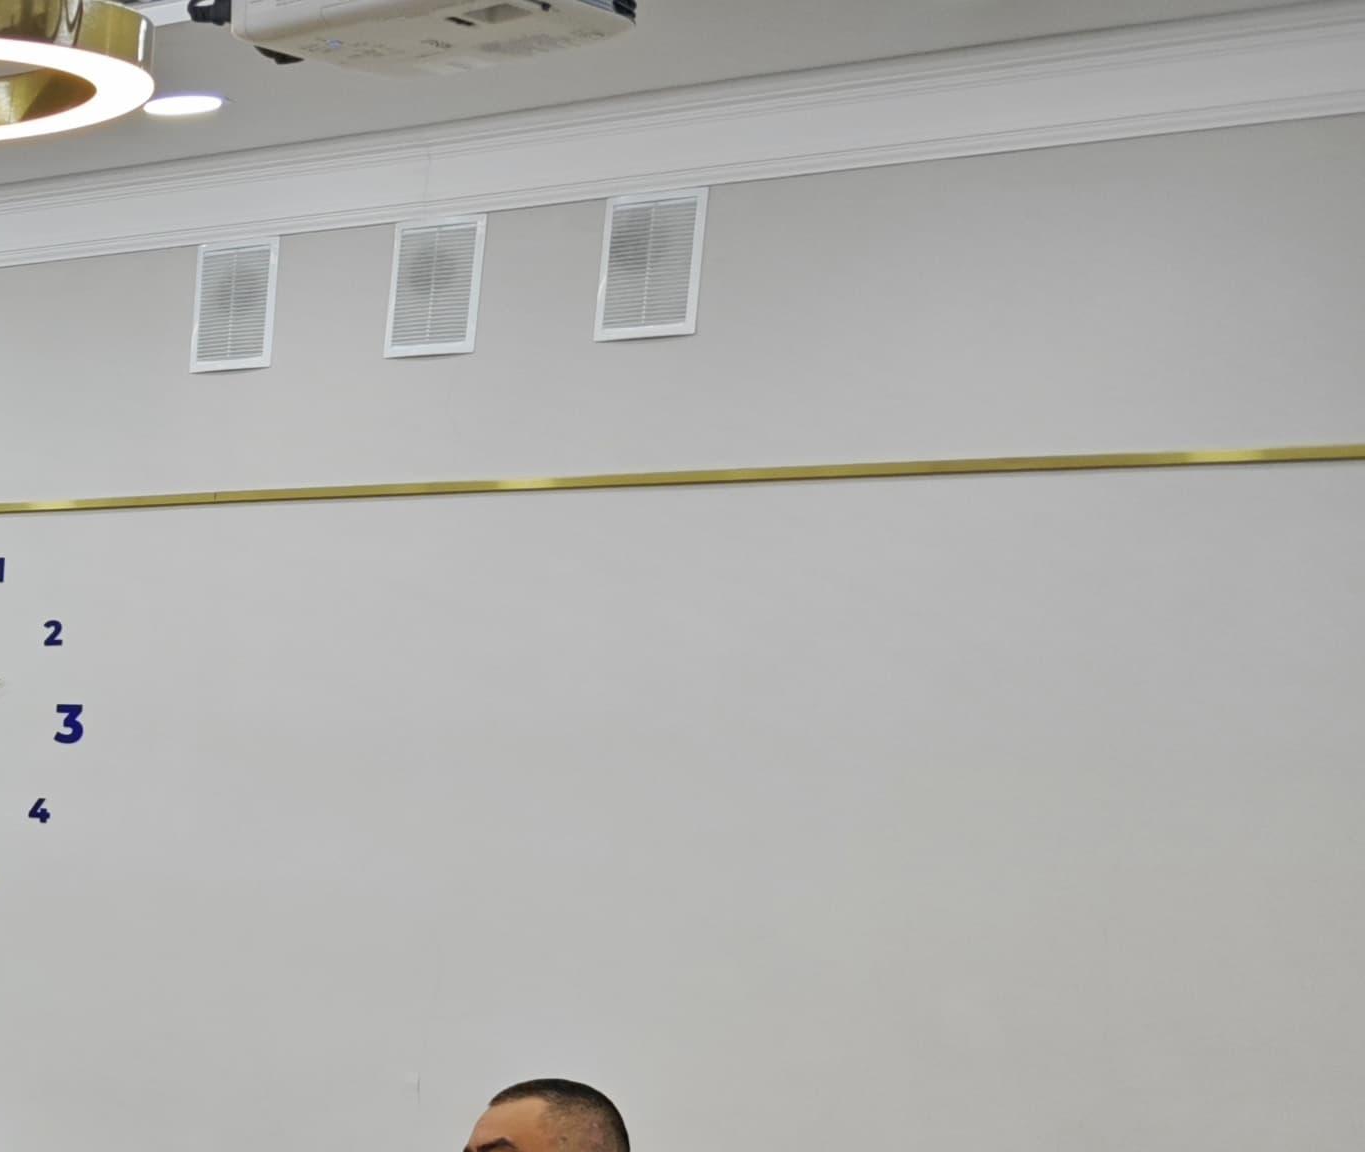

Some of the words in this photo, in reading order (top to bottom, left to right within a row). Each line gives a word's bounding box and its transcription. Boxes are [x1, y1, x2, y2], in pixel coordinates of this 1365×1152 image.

[42, 619, 63, 647] 2
[53, 704, 84, 744] 3
[28, 798, 51, 823] 4
